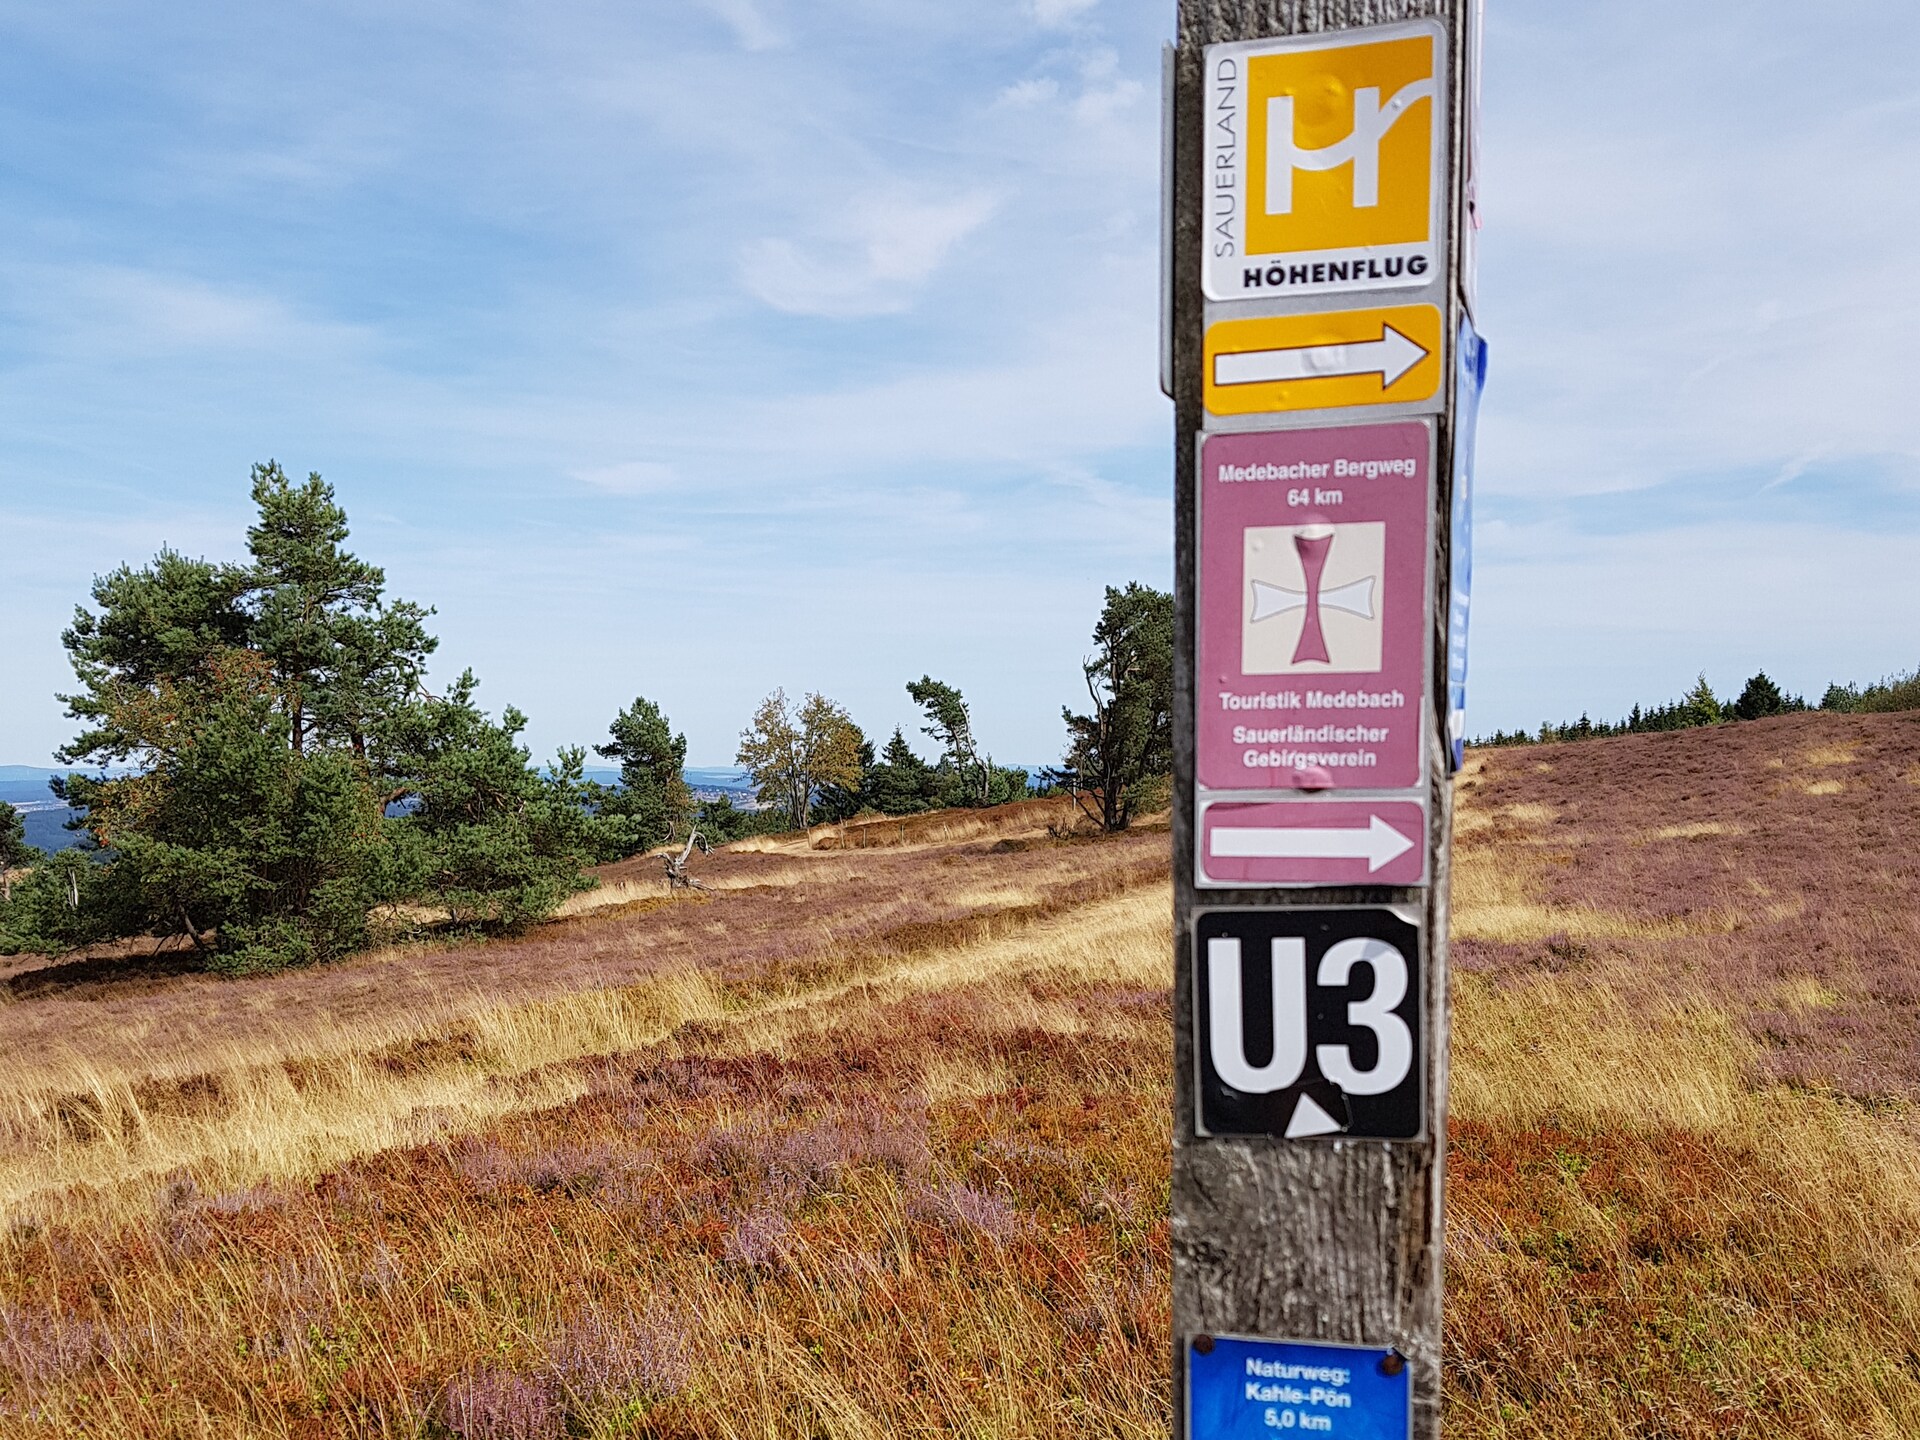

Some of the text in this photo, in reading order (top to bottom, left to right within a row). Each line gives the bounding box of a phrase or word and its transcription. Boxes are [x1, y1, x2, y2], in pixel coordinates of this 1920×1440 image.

[1215, 57, 1238, 258] SAUERLAND
[1243, 254, 1429, 288] HÖHENFLUG
[1218, 458, 1417, 482] Medebacher Bergweg
[1287, 487, 1343, 506] 64 km
[1219, 690, 1404, 710] Touristik Medebach
[1233, 725, 1389, 744] Sauerländischer
[1243, 748, 1377, 771] Gebirgsverein
[1208, 936, 1413, 1096] U3
[1246, 1357, 1351, 1386] Naturweg:
[1245, 1382, 1351, 1408] Kahle-Pön
[1264, 1408, 1332, 1431] 5,0 km
